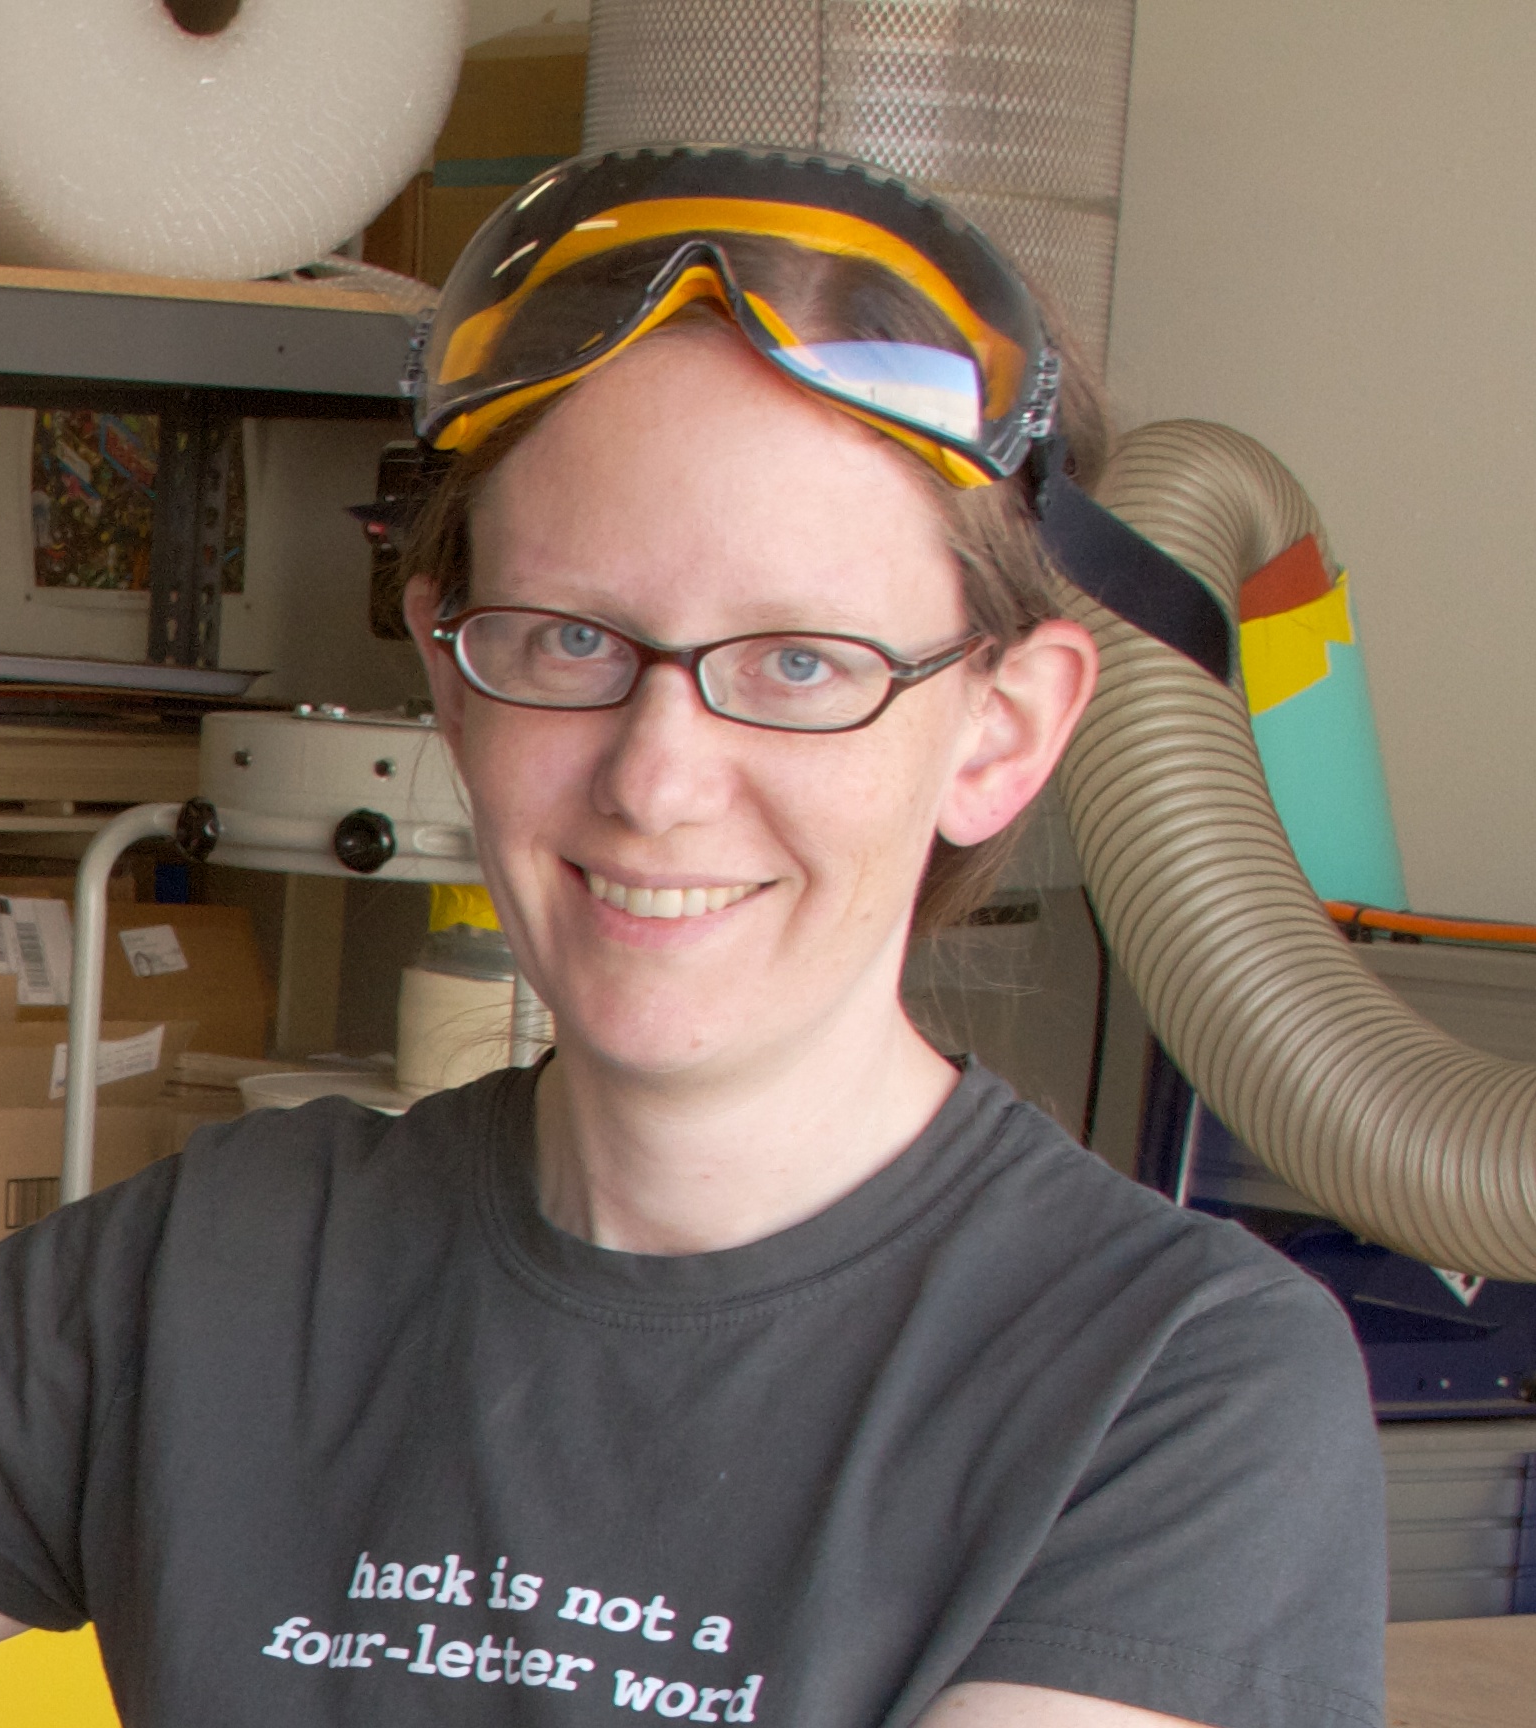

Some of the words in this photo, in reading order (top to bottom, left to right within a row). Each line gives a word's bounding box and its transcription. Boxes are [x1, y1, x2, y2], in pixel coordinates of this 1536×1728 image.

[347, 1551, 476, 1608] hack
[487, 1556, 543, 1612] is
[557, 1583, 677, 1643] not
[691, 1613, 733, 1654] a
[261, 1615, 594, 1693] four-letter
[613, 1667, 764, 1724] word
